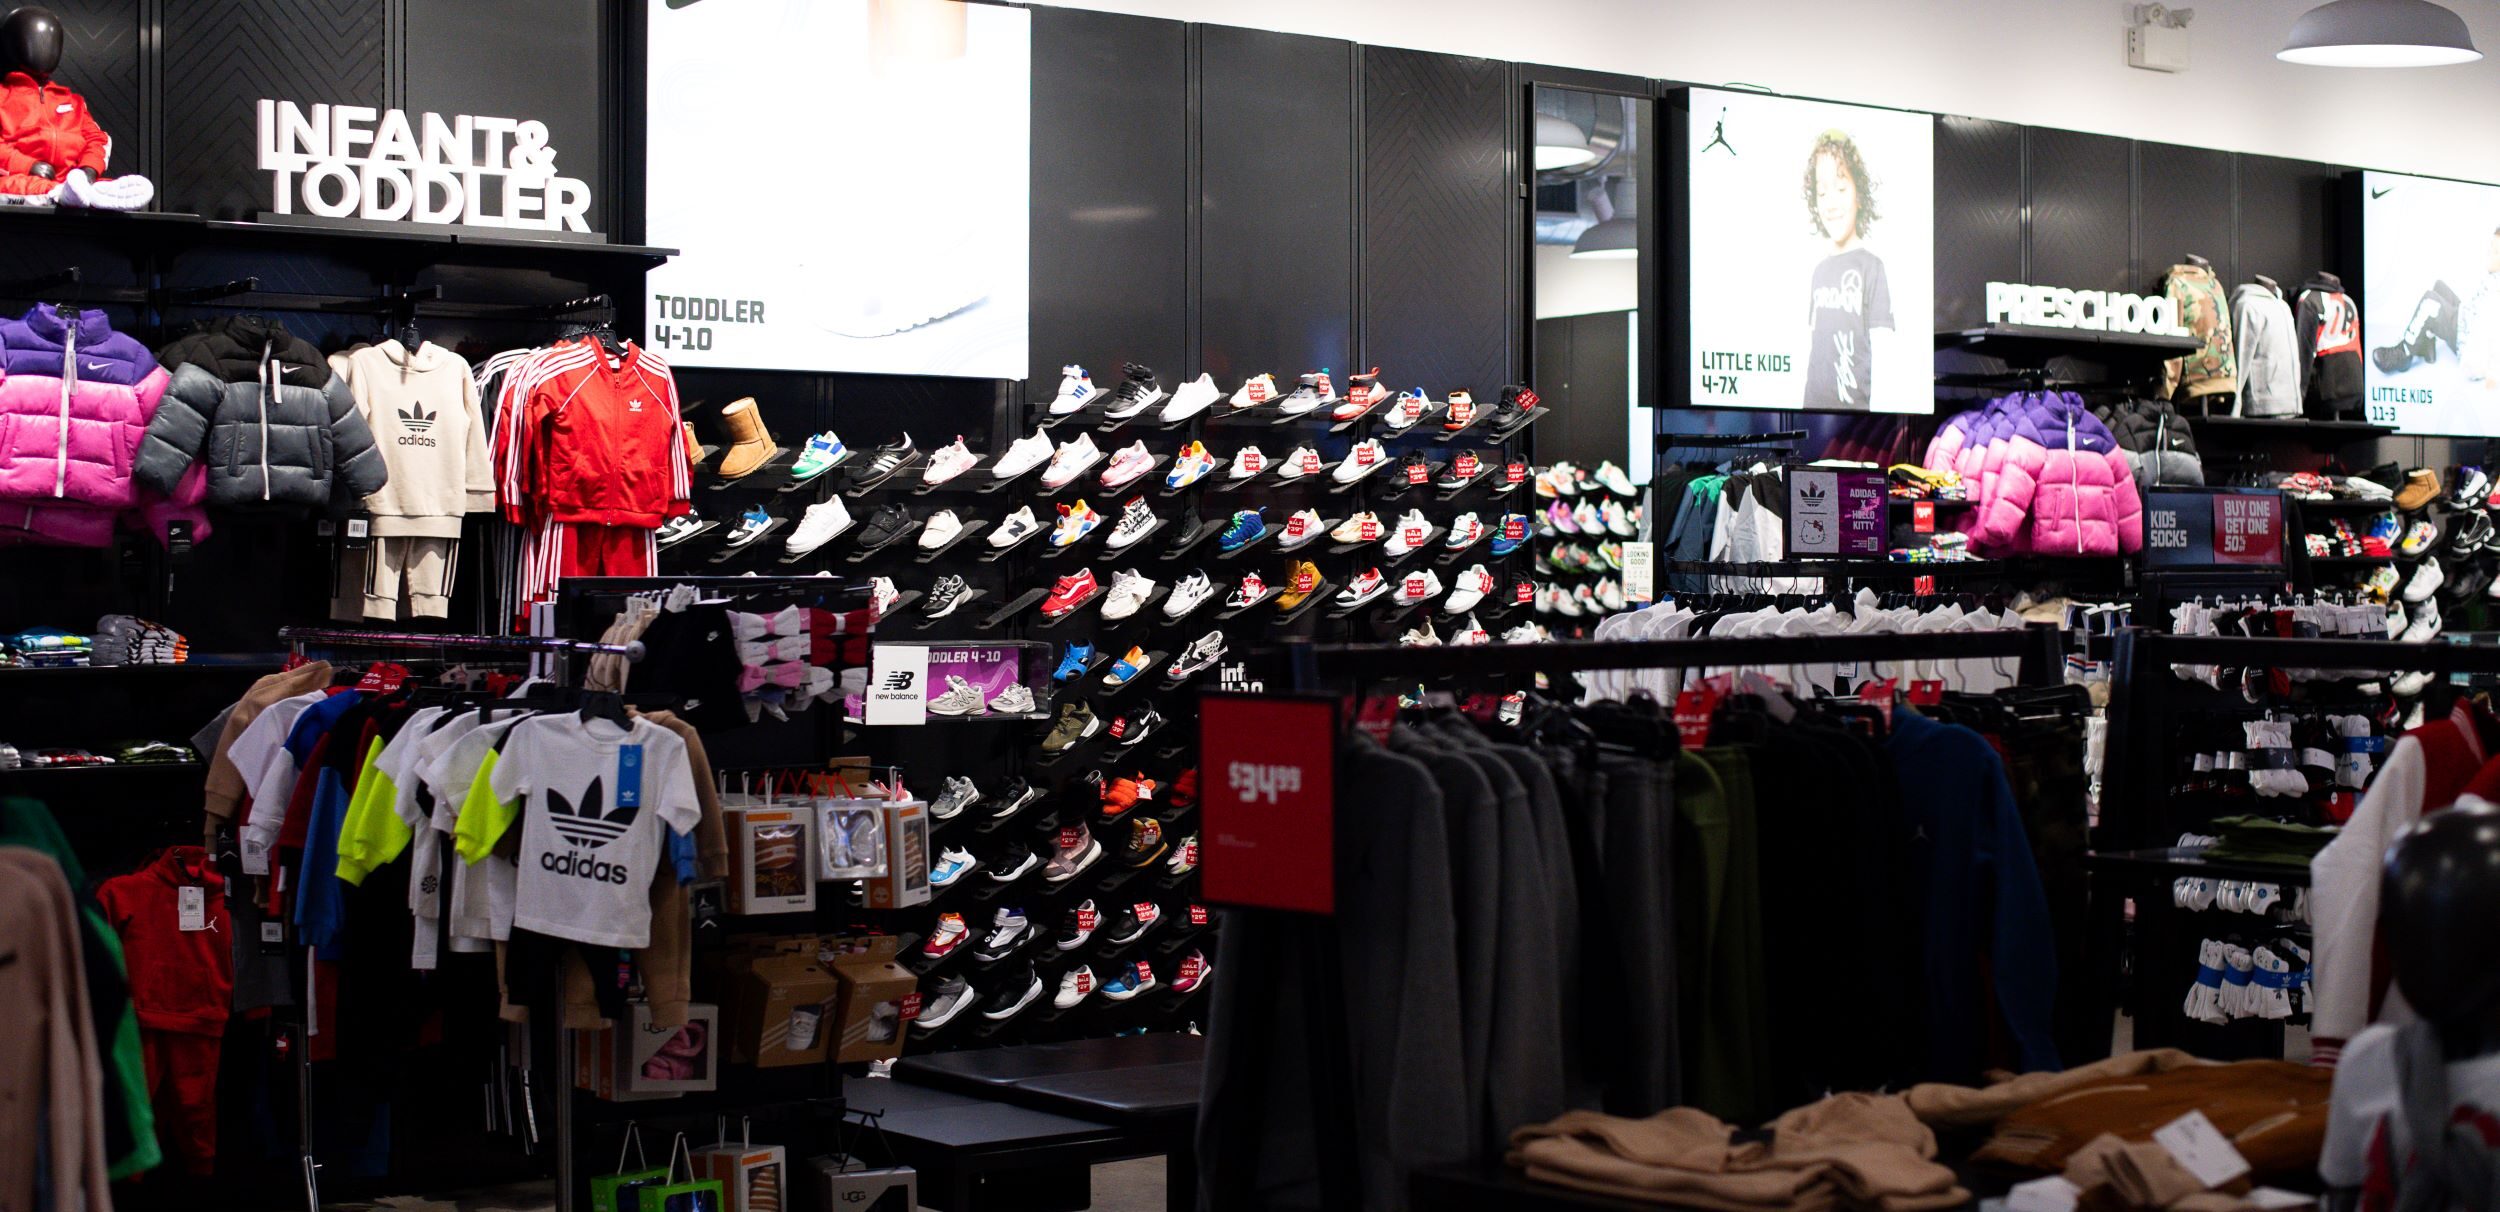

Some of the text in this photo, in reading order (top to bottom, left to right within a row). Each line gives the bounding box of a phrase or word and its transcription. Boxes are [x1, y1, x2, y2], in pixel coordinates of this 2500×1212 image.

[258, 154, 592, 233] TODDLER
[655, 294, 765, 324] TODDLER
[1986, 281, 2189, 337] PRESCHOOL
[655, 324, 713, 351] 4-10
[1702, 351, 1791, 372] LITTLE KIDS
[1702, 375, 1738, 394] 4-7X
[2373, 387, 2432, 404] LITTLE KIDS
[2373, 406, 2395, 421] 11-3
[398, 434, 437, 447] adidas
[1850, 489, 1877, 498] ADIDAS
[1852, 510, 1875, 519] HELLO
[2224, 500, 2270, 517] BUY ONE
[1853, 521, 1874, 530] KITTY
[2151, 511, 2176, 528] KIDS
[2225, 518, 2268, 534] GET ONE
[2151, 530, 2187, 547] SOCKS
[927, 651, 968, 663] DDLER
[890, 692, 918, 700] balance
[541, 850, 627, 885] adidas
